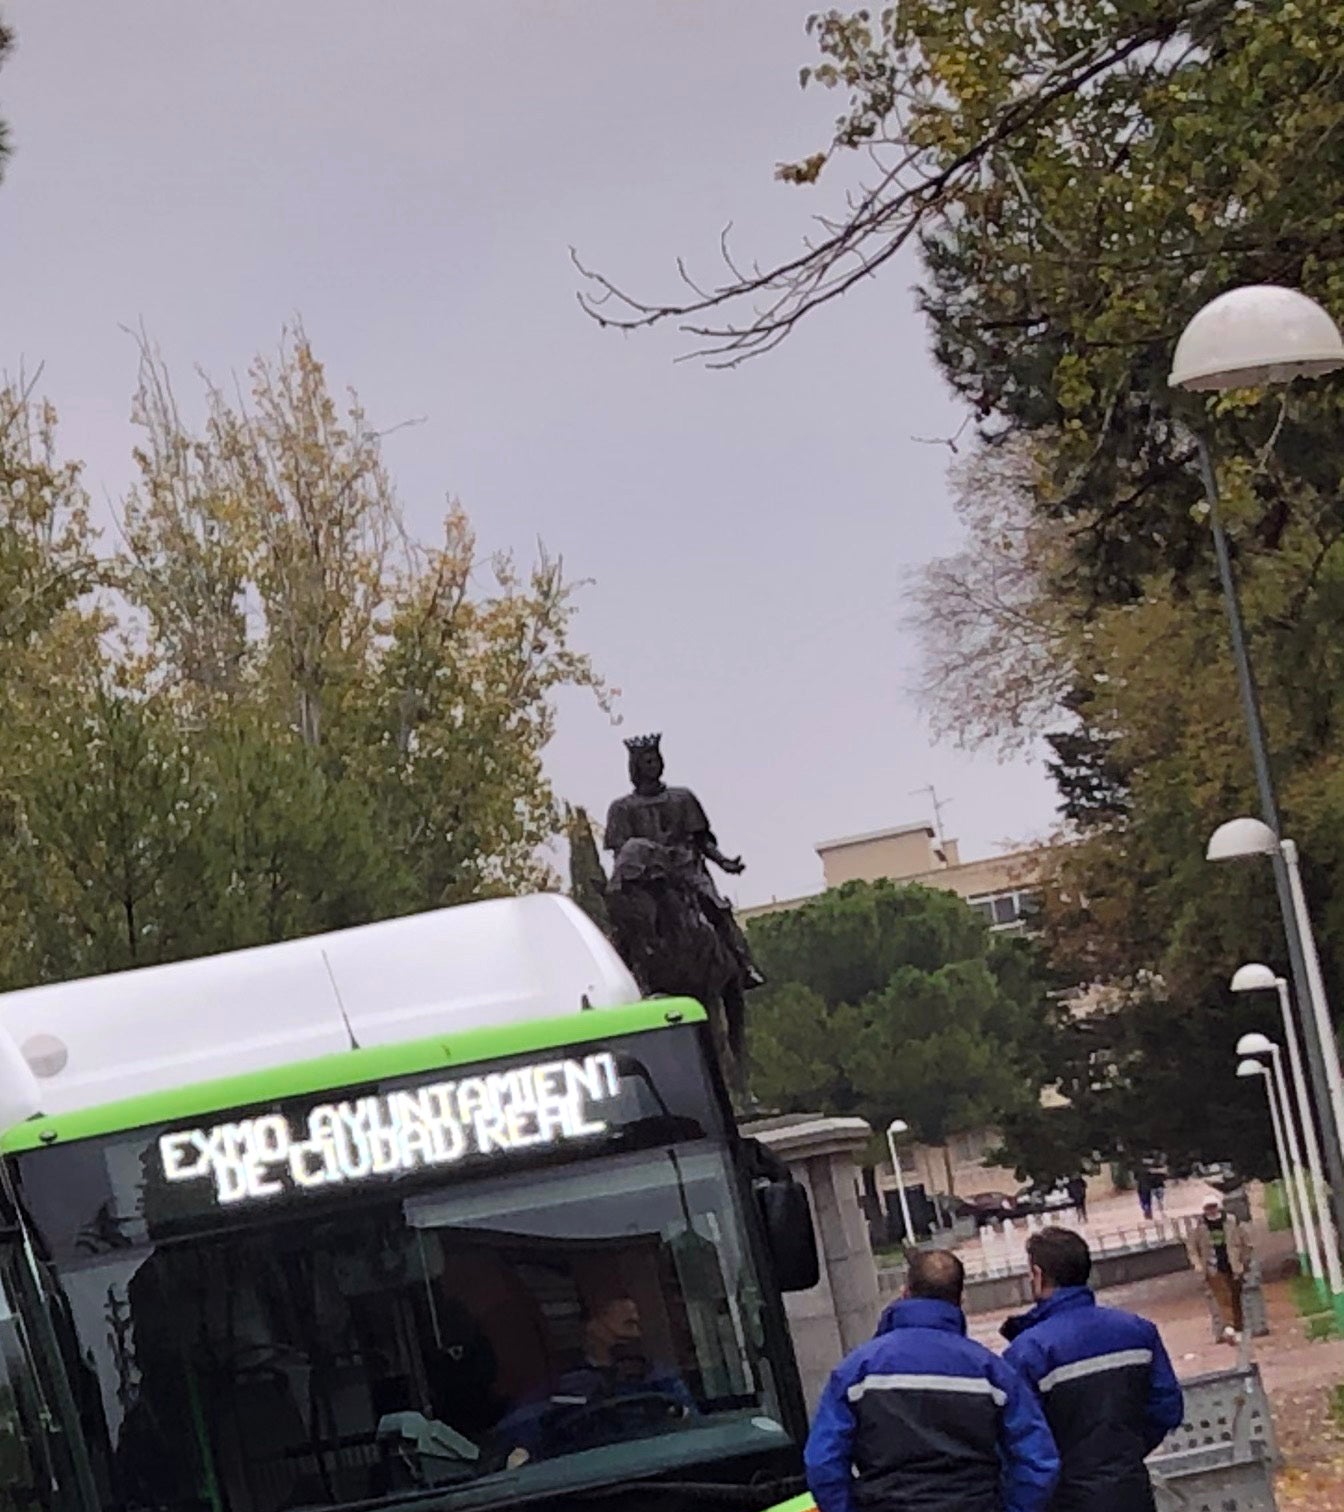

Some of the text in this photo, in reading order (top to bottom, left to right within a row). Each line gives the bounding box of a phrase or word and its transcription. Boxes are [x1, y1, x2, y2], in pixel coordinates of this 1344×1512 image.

[214, 1100, 608, 1204] DE CIUDAD REAL
